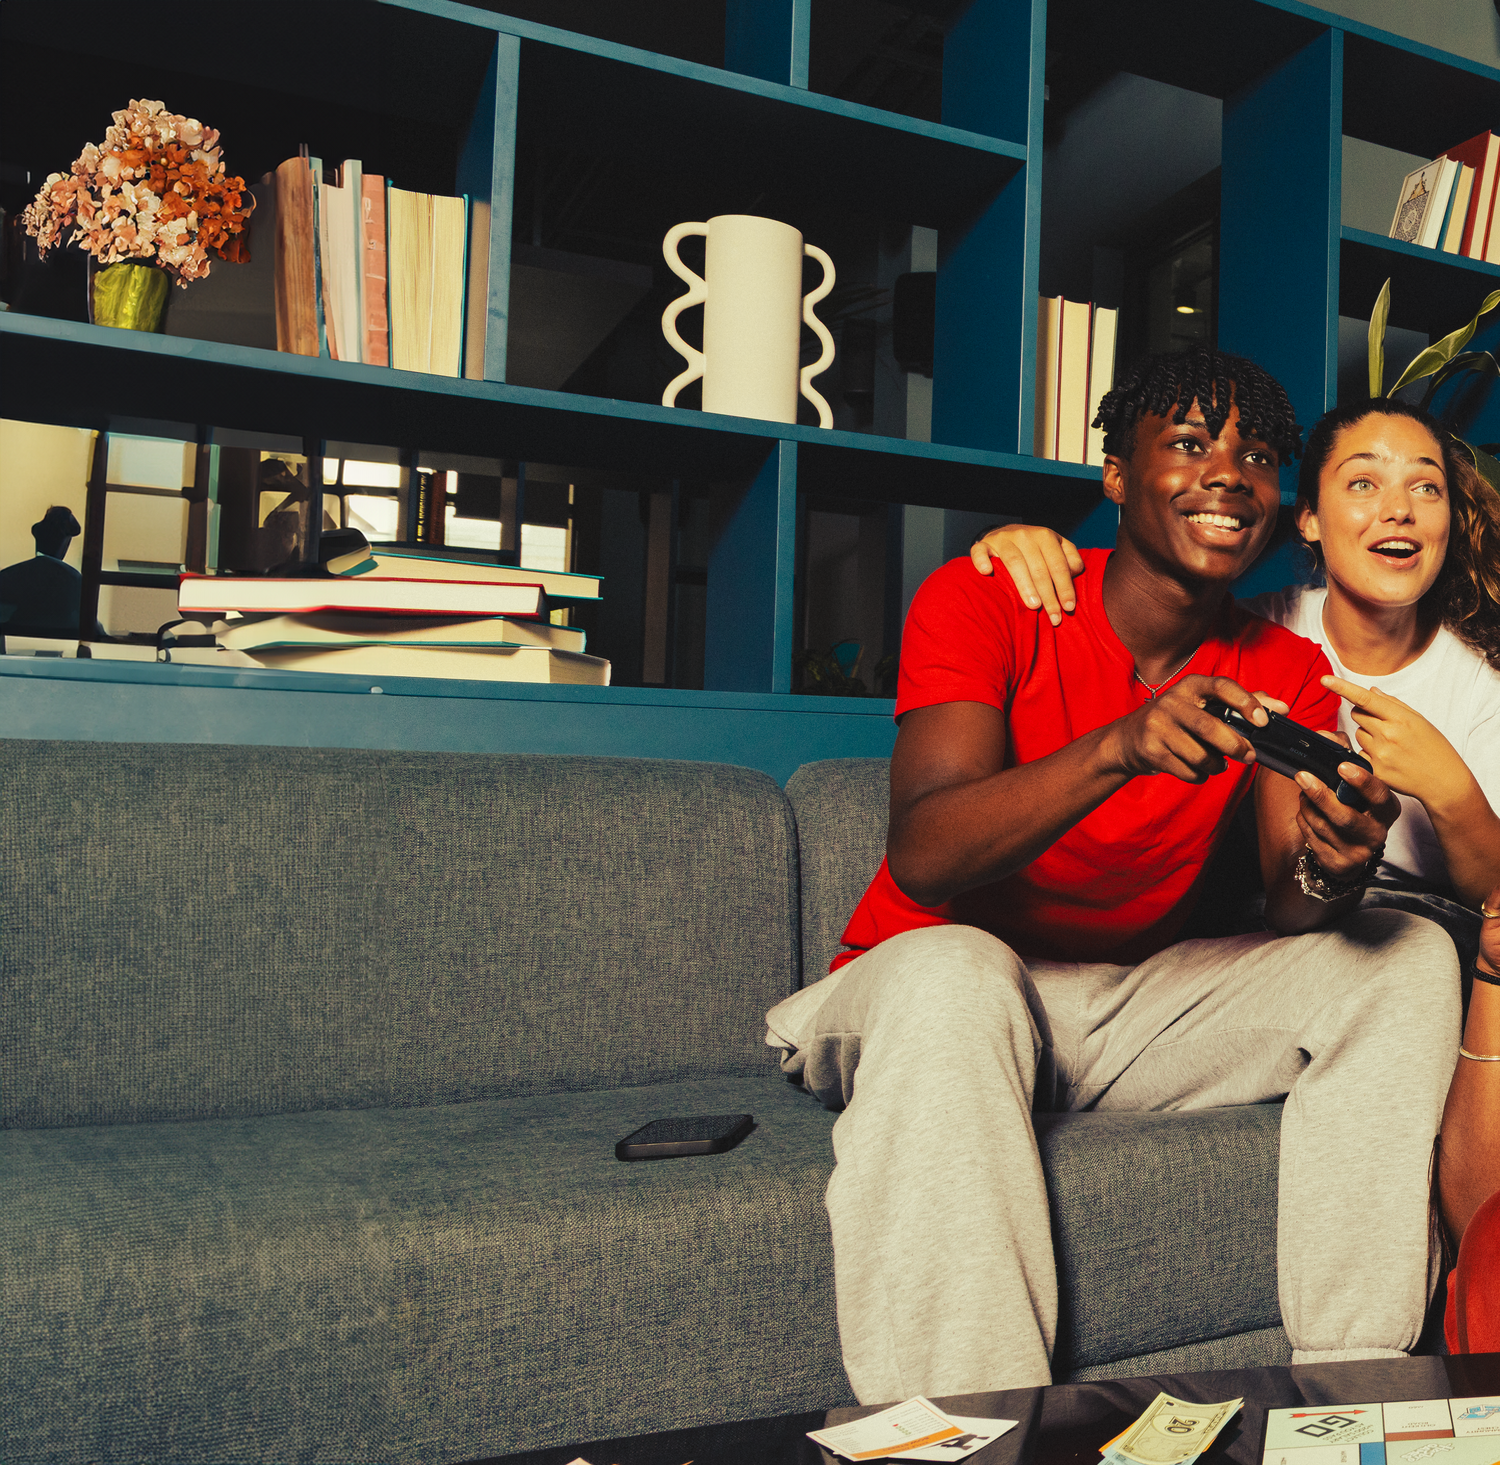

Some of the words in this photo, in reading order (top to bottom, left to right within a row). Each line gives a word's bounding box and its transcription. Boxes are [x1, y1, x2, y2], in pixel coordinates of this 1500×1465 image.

[1164, 1415, 1200, 1434] 20
[1295, 1414, 1359, 1439] GO
[1344, 1429, 1375, 1443] COLLECT
